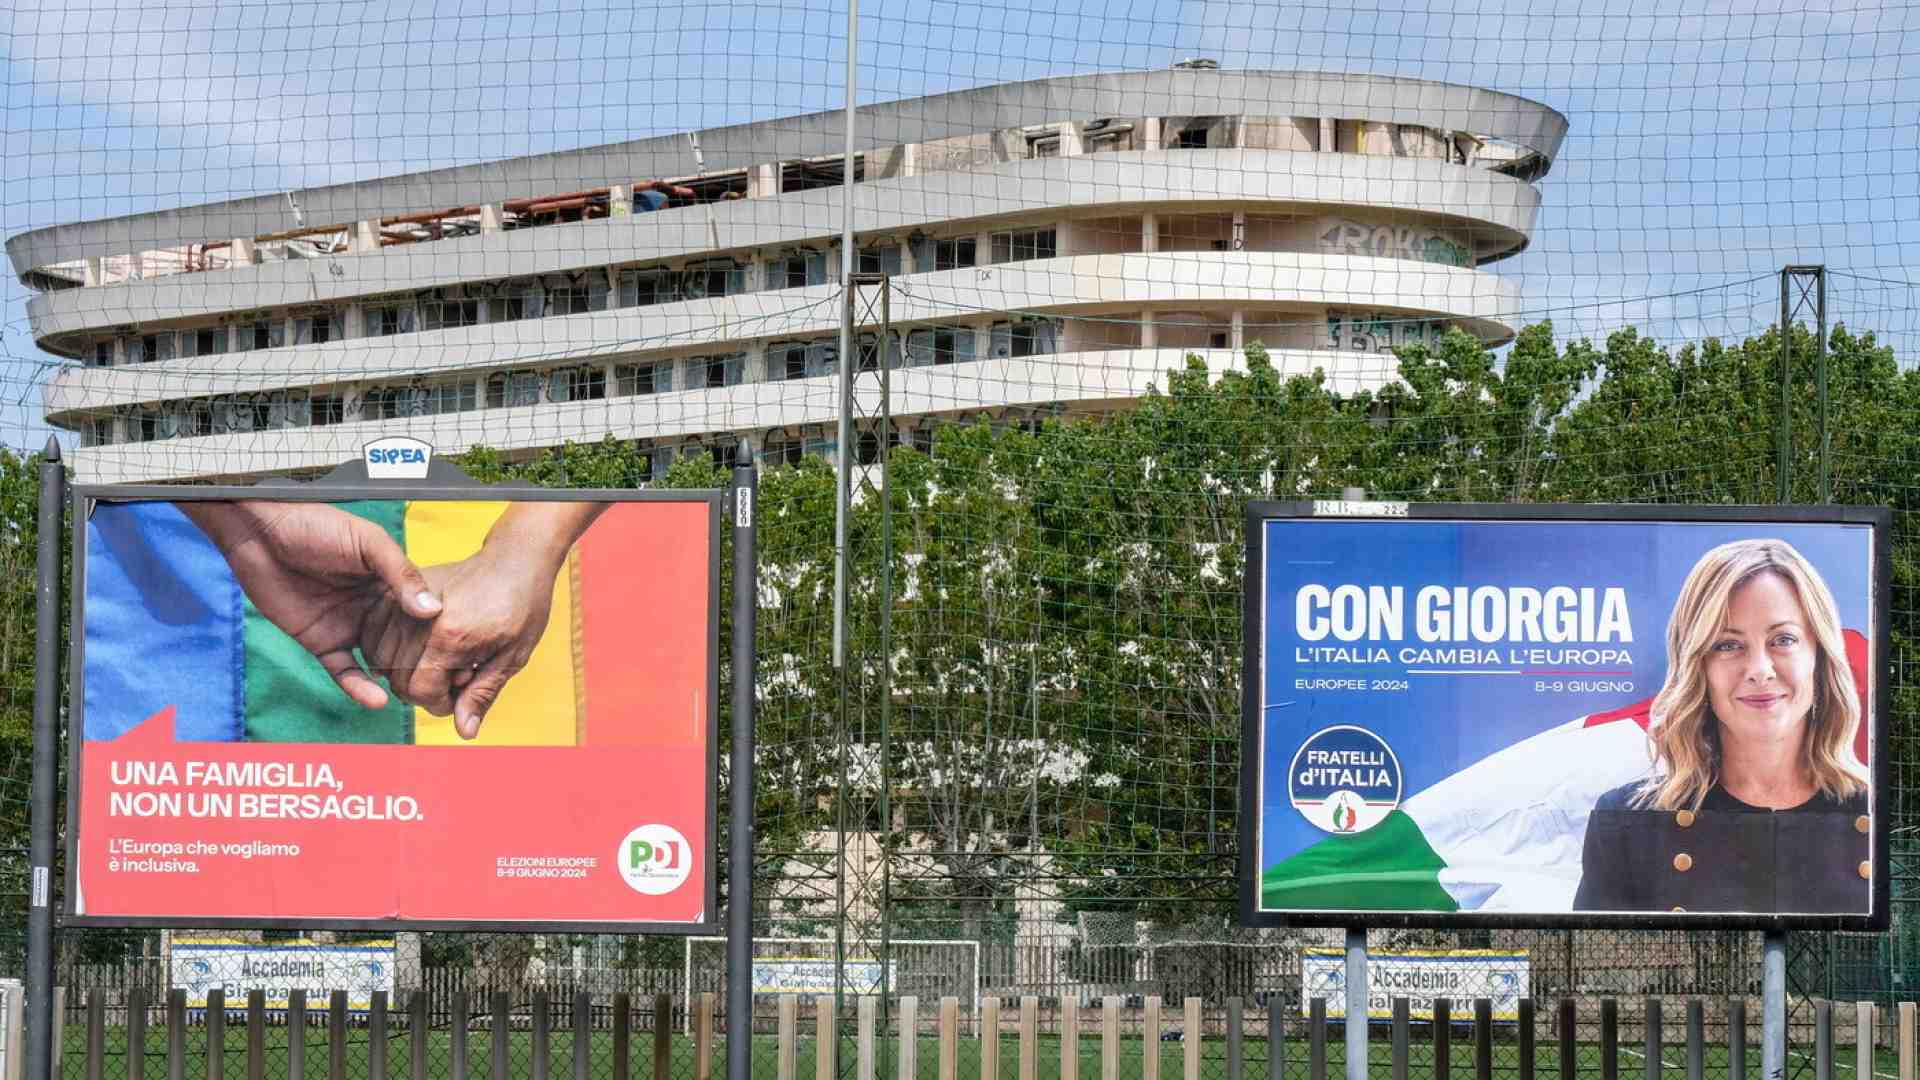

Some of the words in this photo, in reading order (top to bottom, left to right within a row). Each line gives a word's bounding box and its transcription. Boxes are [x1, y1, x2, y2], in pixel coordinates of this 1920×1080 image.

[1295, 584, 1403, 642] CON
[1416, 585, 1633, 644] GIORGIA
[1295, 647, 1391, 664] L'ITALIA
[1399, 648, 1501, 665] CAMBIA
[1511, 649, 1633, 666] L'EUROPA
[1295, 679, 1367, 691] EUROPEE
[1371, 680, 1409, 691] 2024
[1568, 681, 1634, 693] GIUGNO
[1307, 750, 1385, 766] FRATELLI
[110, 761, 179, 786] UNA
[186, 761, 343, 792] FAMIGLIA,
[1299, 767, 1392, 787] d'ITALIA
[109, 792, 181, 817] NON
[187, 793, 233, 818] UN
[239, 794, 424, 821] BERSAGLIO.
[109, 838, 183, 857] L'Europa
[186, 840, 218, 855] che
[221, 841, 300, 859] vogliamo
[631, 840, 680, 870] PD
[109, 857, 120, 872] è
[123, 857, 200, 873] inclusiva.
[496, 857, 547, 868] ELEZIONI
[548, 857, 599, 869] EUROPEE
[496, 867, 515, 878] 8-9
[517, 868, 560, 878] GIUGNO
[560, 868, 587, 879] 2024
[242, 956, 325, 978] Accademia
[1374, 964, 1458, 990] Accademia
